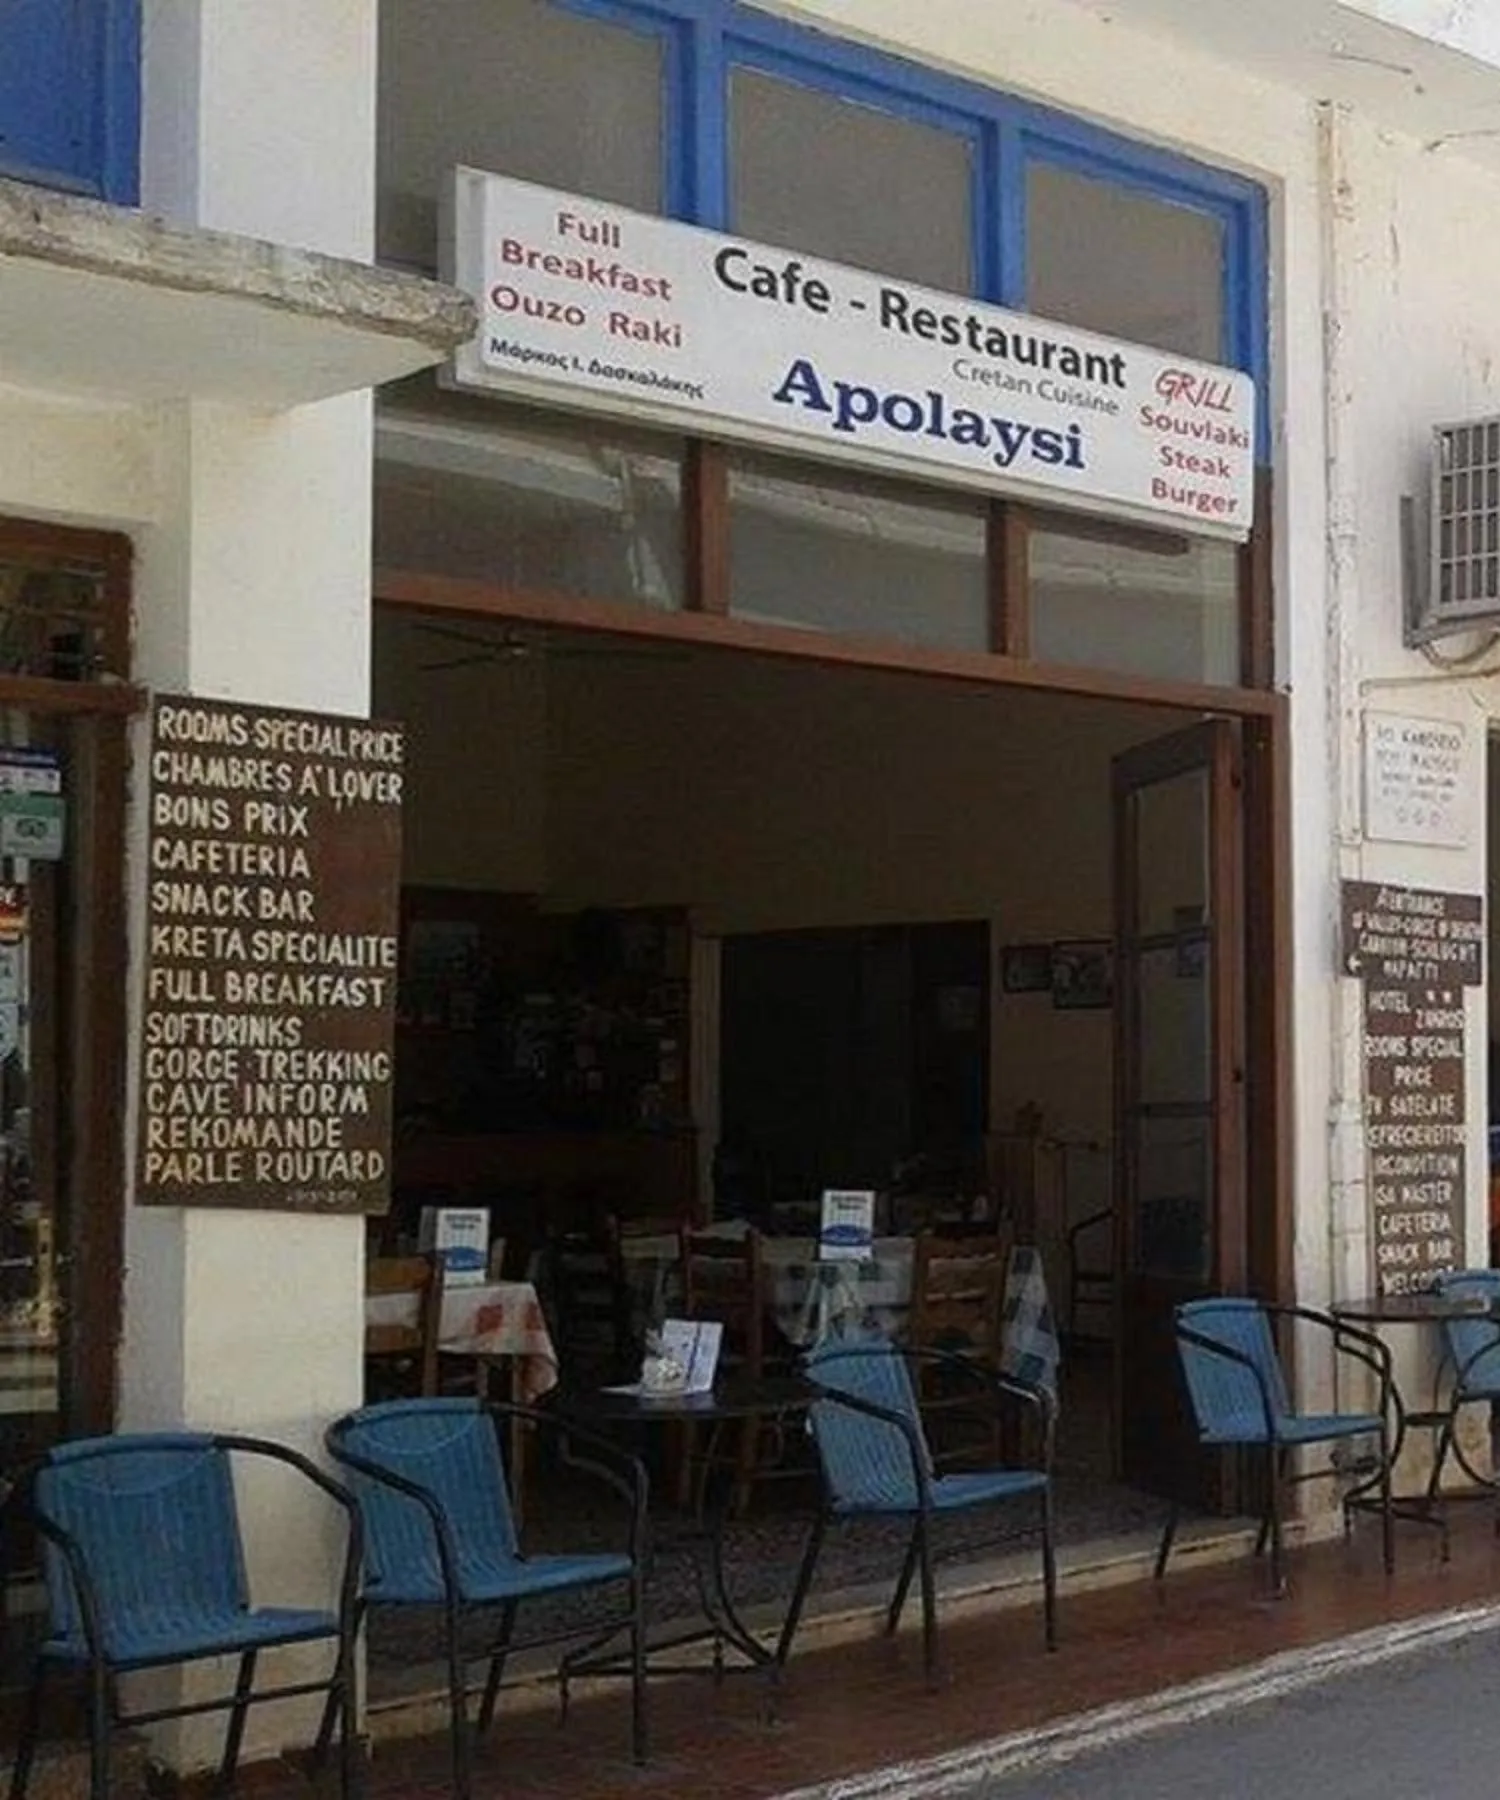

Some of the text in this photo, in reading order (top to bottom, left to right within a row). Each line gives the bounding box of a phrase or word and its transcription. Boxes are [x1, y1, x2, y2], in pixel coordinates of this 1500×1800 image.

[557, 211, 621, 249] Full
[500, 238, 673, 302] Breakfast
[490, 285, 683, 349] Ouzo Raki
[714, 246, 830, 314] Cafe
[880, 287, 1126, 389] Restaurant
[953, 358, 1120, 417] Cretan Cuisine
[1156, 368, 1232, 413] GRILL
[772, 358, 1086, 469] Apolaysi
[1140, 405, 1249, 449] Souvlaki
[1160, 446, 1231, 479] Steak
[1152, 477, 1238, 513] Burger
[157, 706, 403, 763] ROOMS SPECIAL PRICE
[153, 750, 293, 792] CHAMBRES
[154, 792, 309, 837] BONS PRIX
[152, 837, 311, 879] CAFETERIA
[151, 880, 315, 923] SNACK BAR
[150, 925, 398, 968] KRETA SPECIALITE
[150, 967, 385, 1008] FULL BREAKFAST
[1369, 990, 1411, 1014] HOTEL
[255, 1050, 392, 1082] TREKKING
[1410, 1035, 1463, 1058] SPECIAL
[1393, 1065, 1433, 1087] PRICE
[146, 1082, 369, 1115] CAVE INFORM
[147, 1117, 343, 1149] REKOMANDE
[144, 1150, 385, 1185] PARLE ROUTARD
